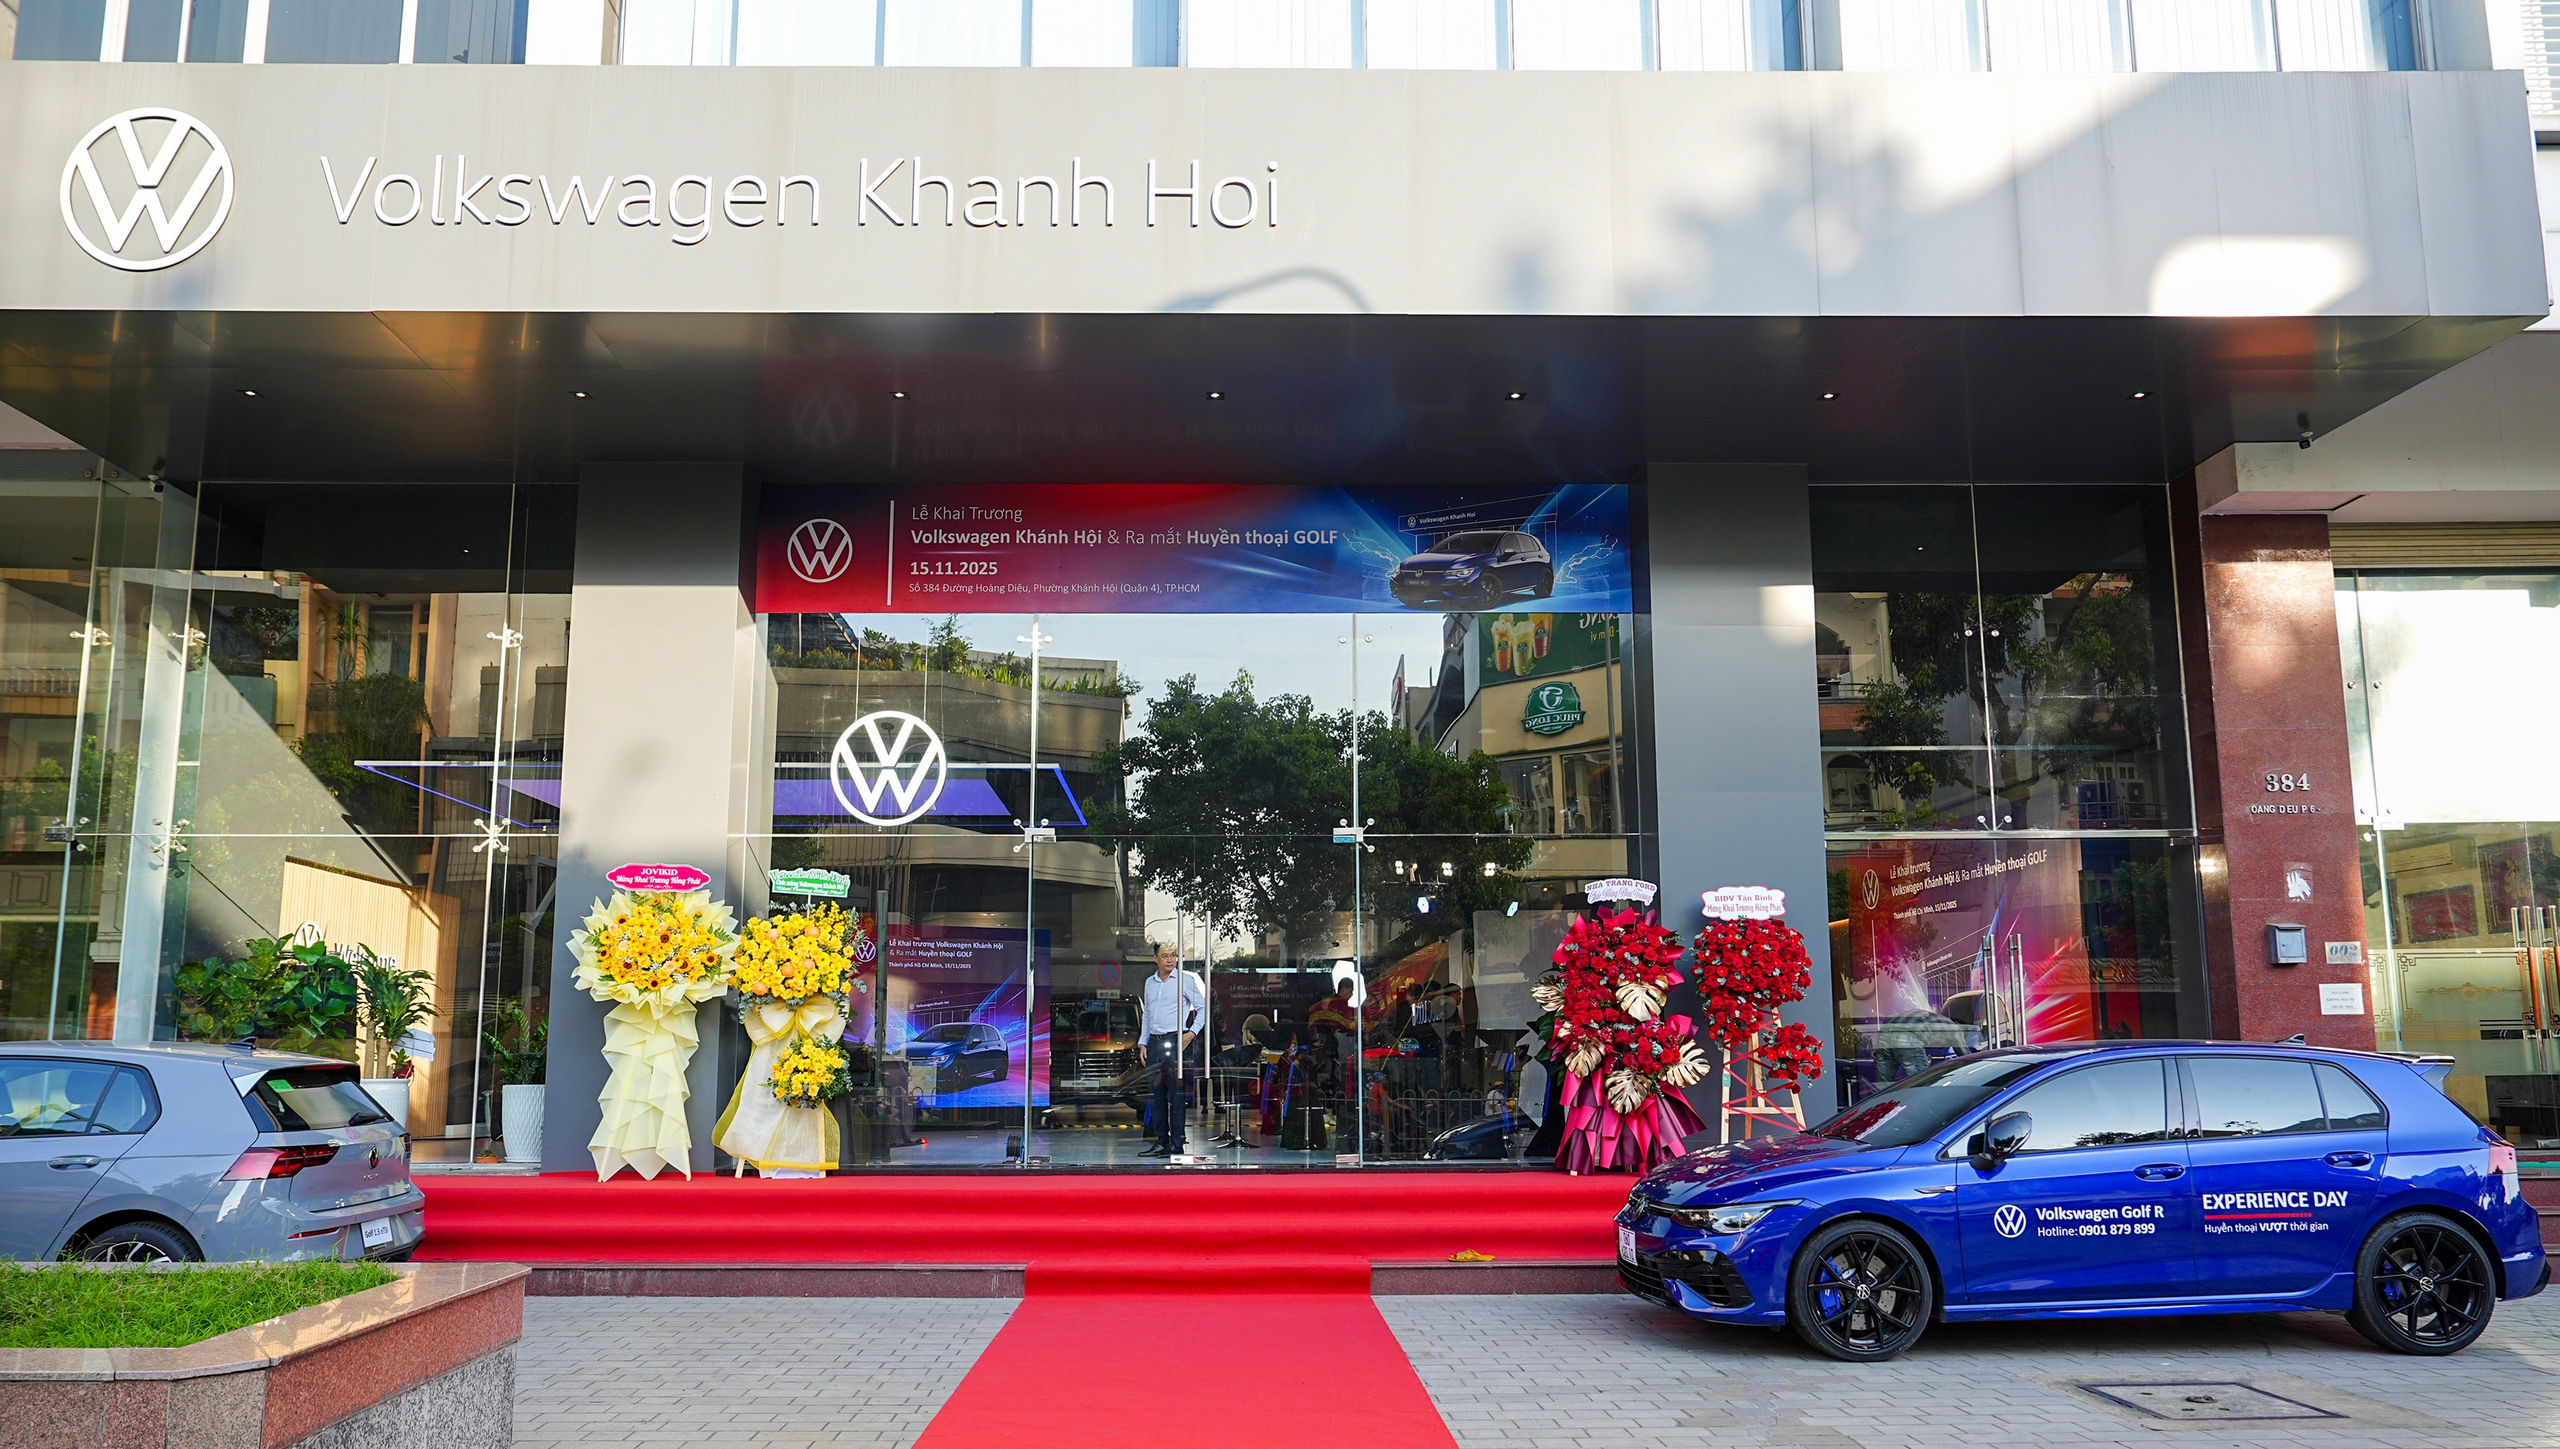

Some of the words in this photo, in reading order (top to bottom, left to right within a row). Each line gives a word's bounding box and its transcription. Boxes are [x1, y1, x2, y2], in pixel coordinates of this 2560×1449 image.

[320, 154, 821, 246] Volkswagen
[857, 157, 1116, 227] Khanh
[1147, 161, 1279, 228] Hoi
[912, 504, 928, 520] Lễ
[933, 506, 965, 520] Khai
[969, 506, 1023, 523] Trương
[1419, 515, 1450, 524] Volkswagen
[911, 529, 1010, 547] Volkswagen
[1016, 528, 1068, 544] Khánh
[1074, 529, 1102, 547] Hội
[1107, 530, 1120, 544] &
[1126, 530, 1145, 544] Ra
[1150, 527, 1182, 545] mắt
[1187, 527, 1239, 548] Huyền
[1245, 529, 1288, 547] thoại
[1293, 530, 1338, 544] GOLF
[910, 561, 998, 576] 15.11.2025
[909, 582, 920, 593] Số
[923, 583, 940, 593] 384
[942, 583, 973, 595] Đường
[975, 583, 1005, 595] Hoàng
[1007, 583, 1031, 595] Diệu,
[1033, 583, 1069, 595] Phường
[1071, 583, 1100, 593] Khánh
[1102, 583, 1118, 595] Hội
[1120, 583, 1149, 594] (Quận
[1150, 583, 1163, 595] 4),
[1165, 584, 1200, 594] TP.HCM
[2266, 773, 2311, 792] 384
[1891, 882, 1923, 896] Volkswagen
[1924, 875, 1943, 889] Khánh
[1944, 872, 1955, 886] Hội
[1955, 871, 1961, 882] &
[1962, 869, 1970, 880] Ra
[2007, 854, 2027, 870] thoại
[2028, 850, 2048, 866] GOLF
[1586, 882, 1603, 891] NHA
[1635, 881, 1655, 891] FORD
[1723, 904, 1735, 912] Khai
[936, 941, 972, 949] Volkswagen
[973, 941, 992, 949] Khánh
[2329, 945, 2357, 956] 002
[2203, 1191, 2309, 1211] EXPERIENCE
[2314, 1190, 2348, 1207] DAY
[2036, 1206, 2119, 1222] Volkswagen
[2121, 1205, 2152, 1219] Golf
[2155, 1206, 2165, 1218] R
[365, 1230, 373, 1238] Golf
[2038, 1224, 2078, 1237] Hotline:
[2079, 1224, 2107, 1236] 0901
[2110, 1223, 2131, 1235] 879
[2134, 1223, 2155, 1235] 899
[2204, 1221, 2232, 1236] Huyền
[2234, 1221, 2257, 1234] thoại
[2259, 1220, 2288, 1233] VƯỢT
[2290, 1220, 2308, 1233] thời
[2310, 1220, 2329, 1234] gian
